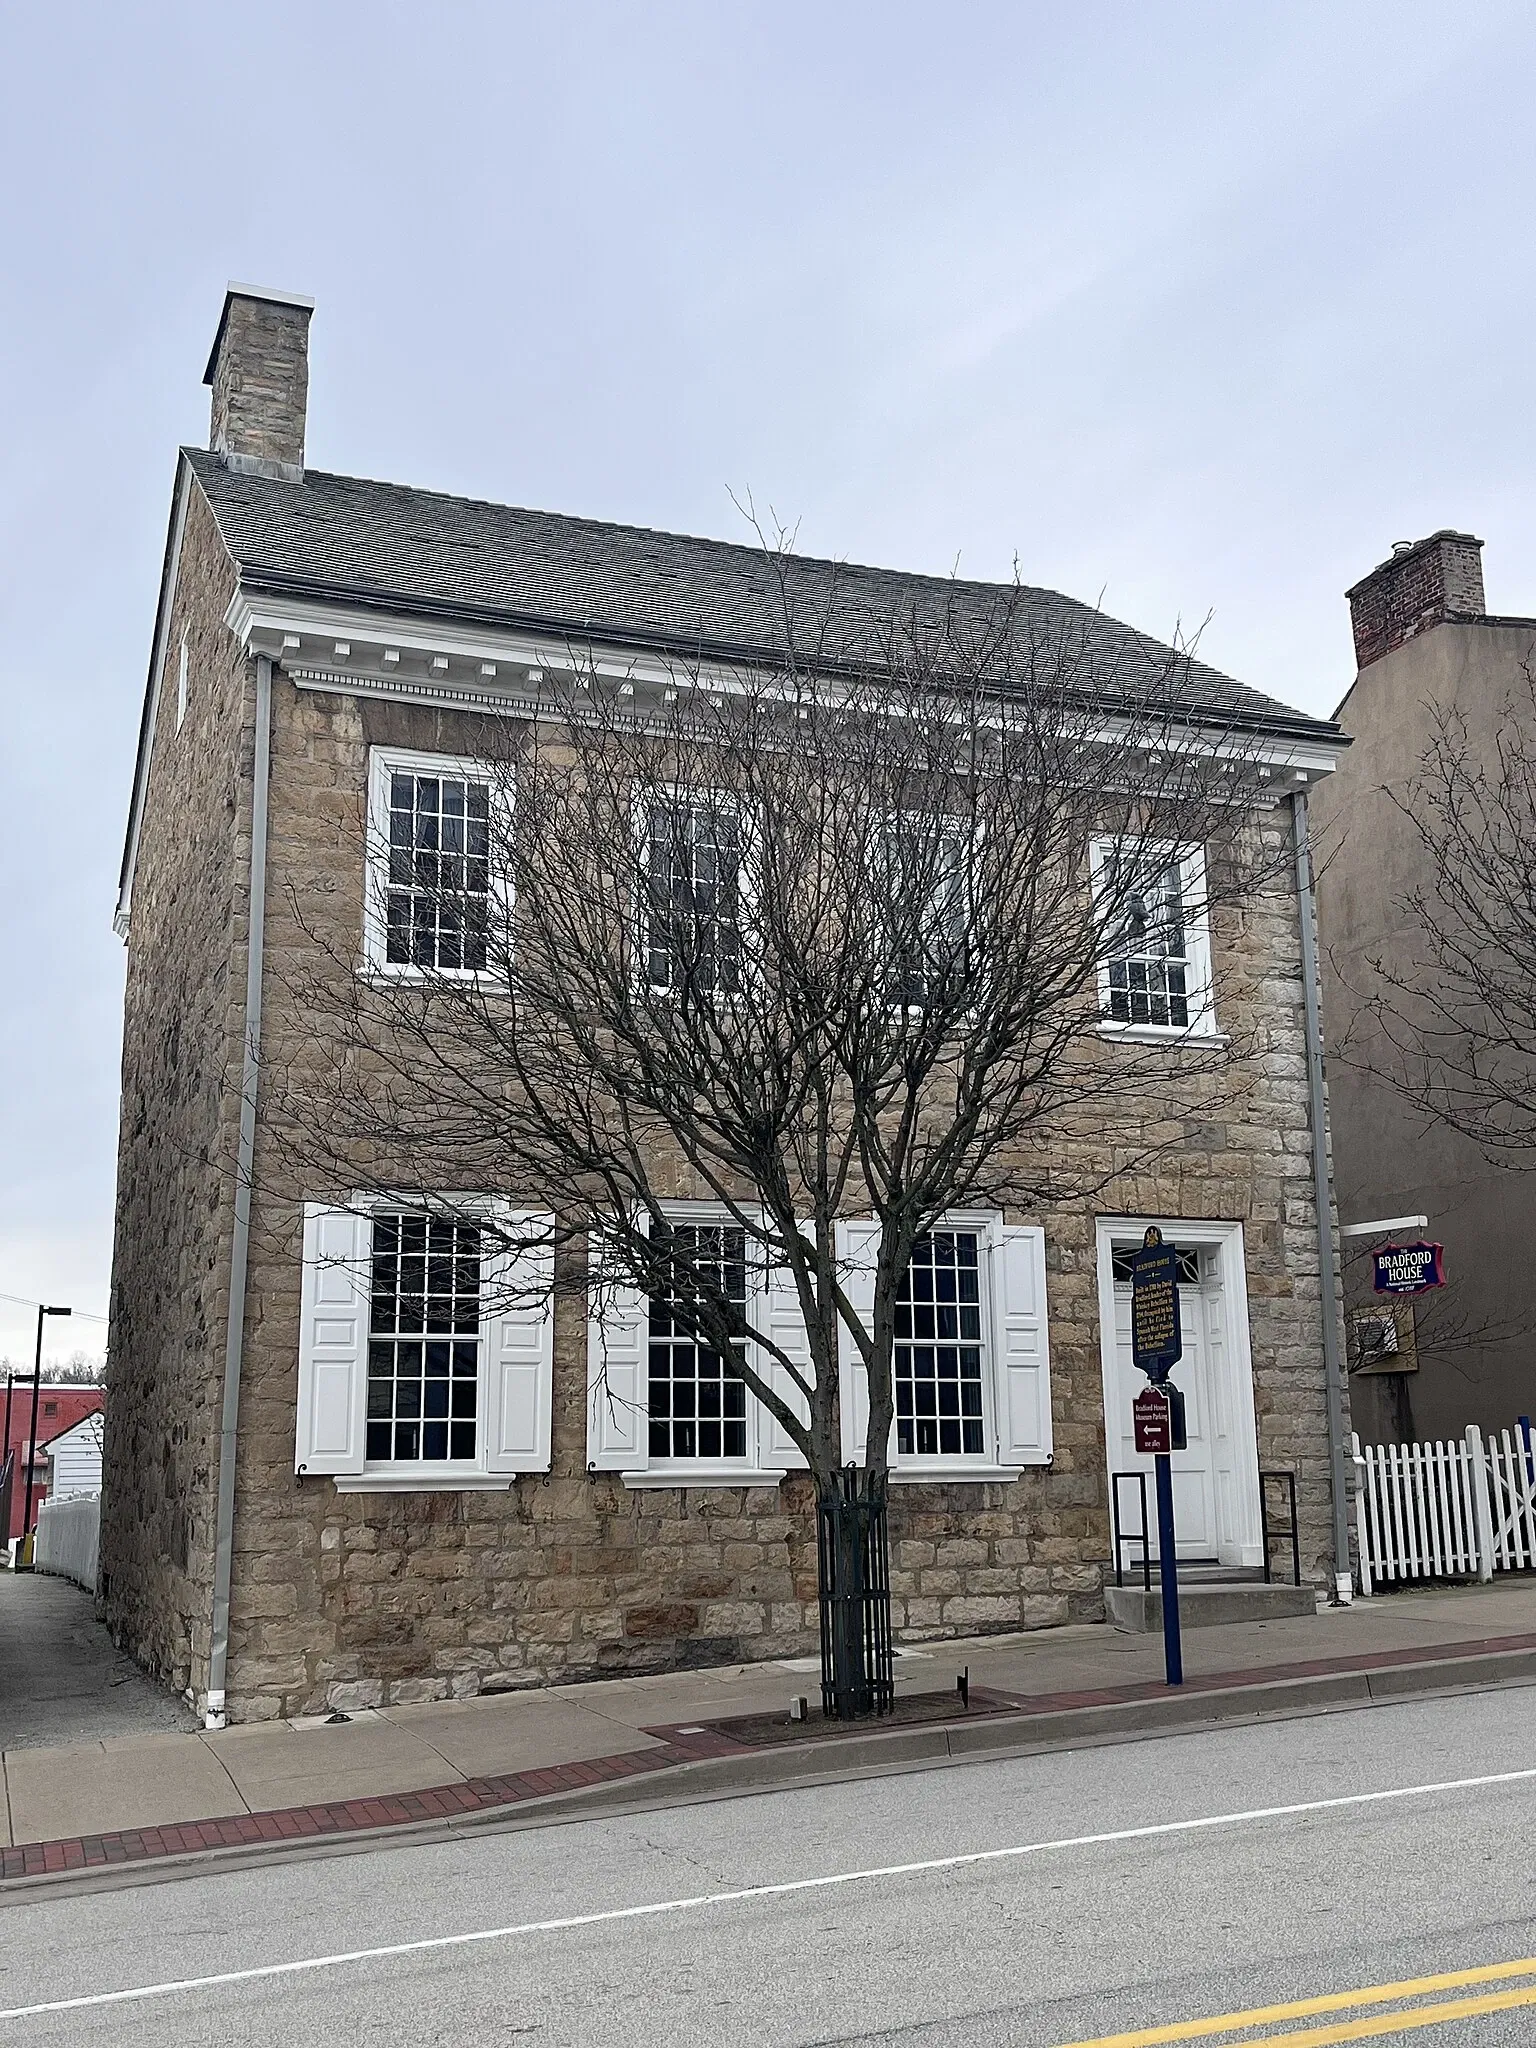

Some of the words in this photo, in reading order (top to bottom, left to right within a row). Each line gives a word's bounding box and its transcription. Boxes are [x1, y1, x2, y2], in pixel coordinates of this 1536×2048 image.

[1136, 1261, 1156, 1272] BRADFORD
[1157, 1257, 1169, 1267] HOUSE
[1379, 1251, 1432, 1269] BRADFORD
[1389, 1266, 1423, 1281] HOUSE
[1153, 1413, 1168, 1422] Parking
[1152, 1440, 1160, 1449] alley
